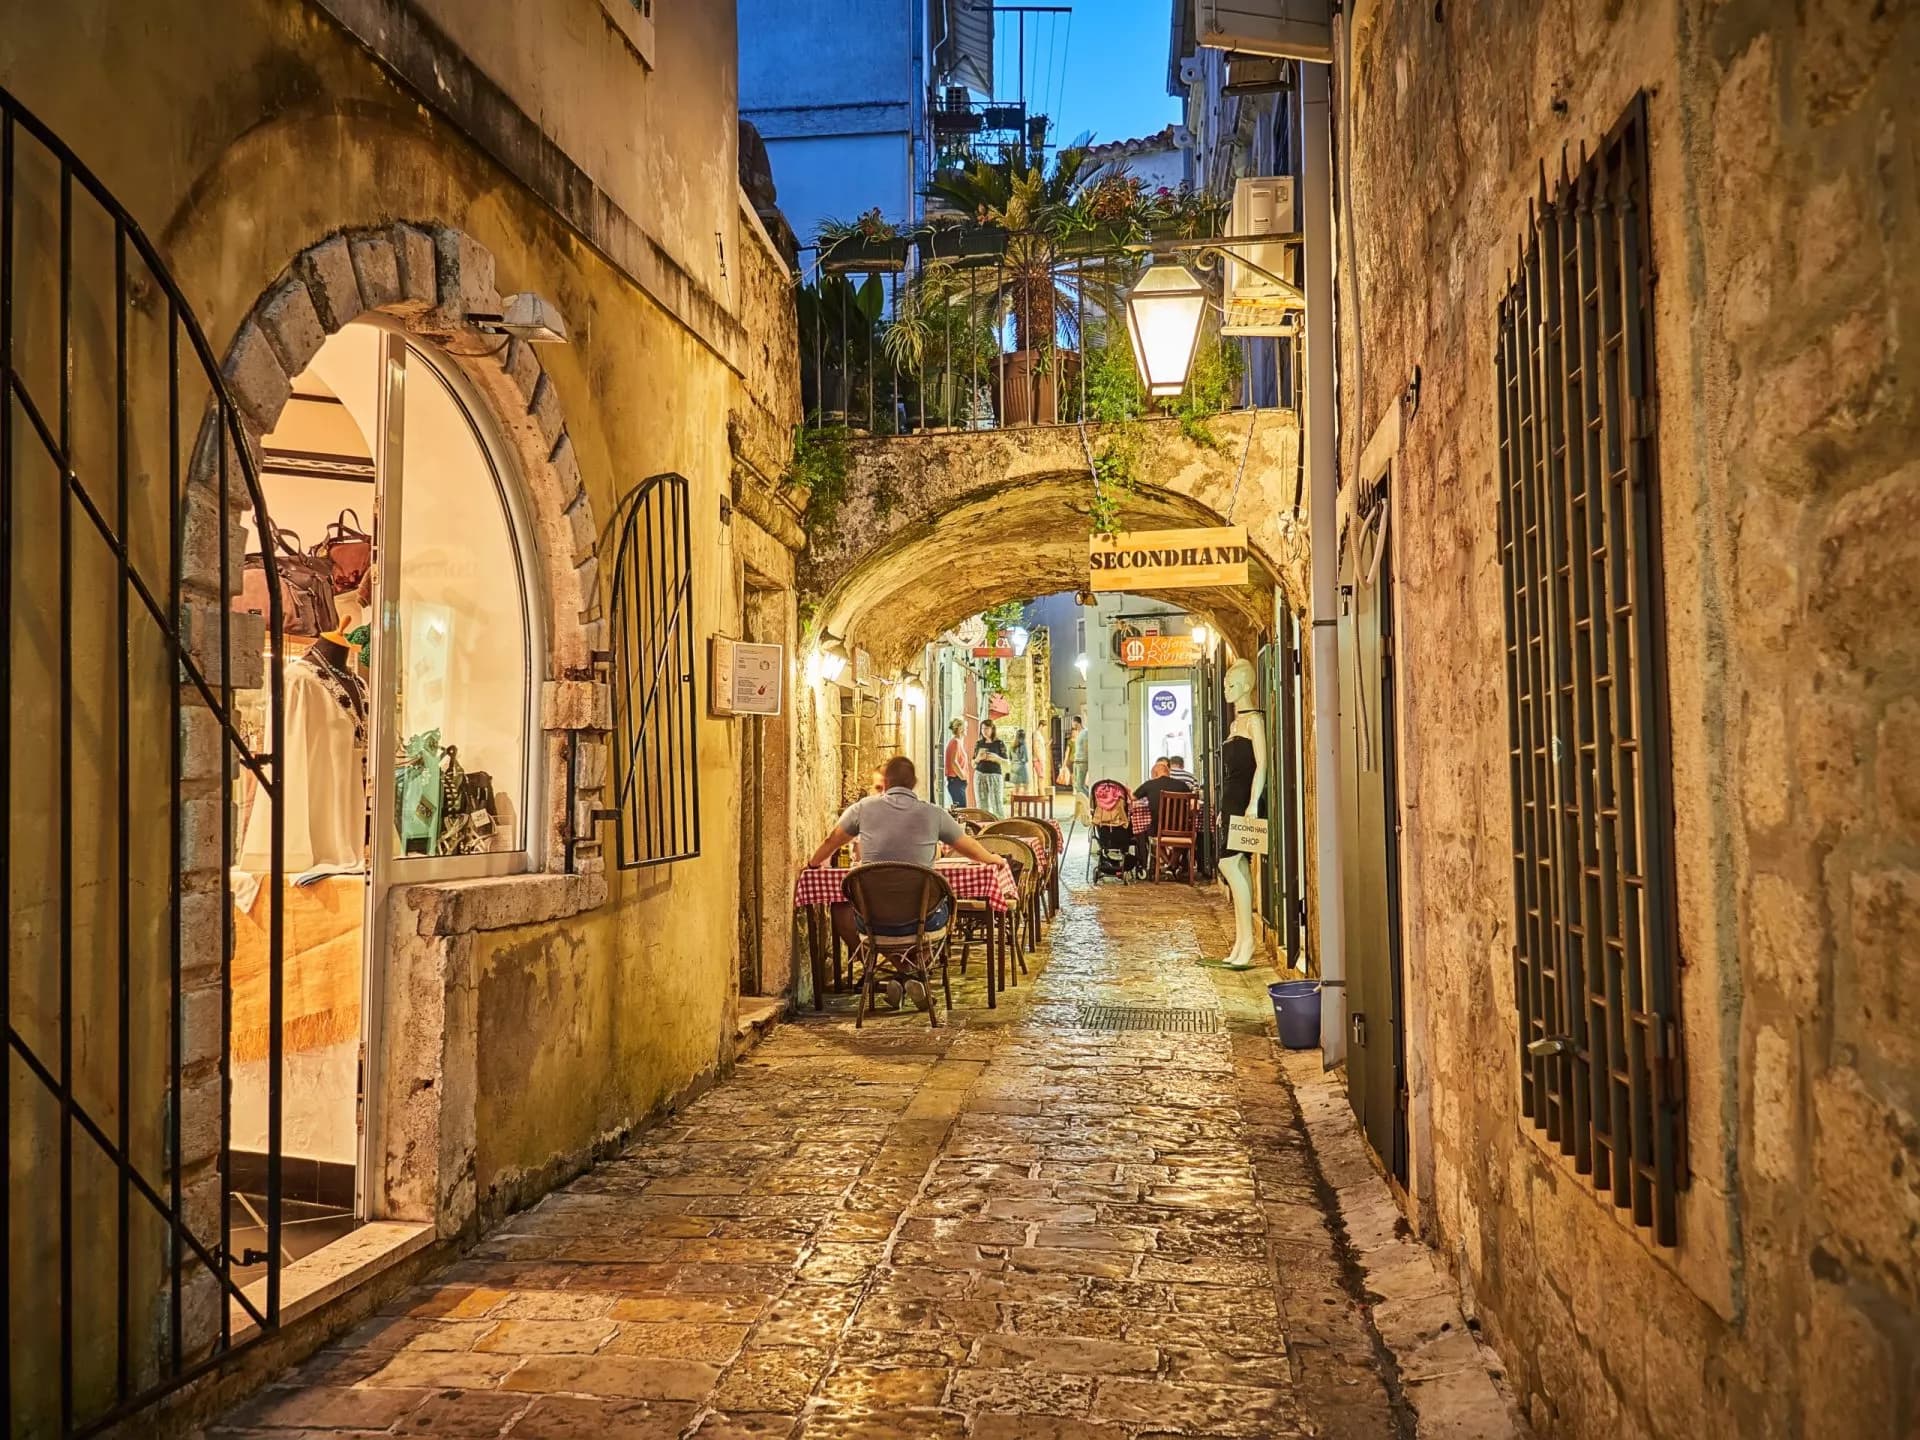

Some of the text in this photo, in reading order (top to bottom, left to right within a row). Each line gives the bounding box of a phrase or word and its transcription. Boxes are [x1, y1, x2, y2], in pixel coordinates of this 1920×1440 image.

[1090, 546, 1248, 570] SECONDHAND
[1231, 824, 1267, 834] SECOND HAND
[1240, 837, 1260, 846] SHOP
